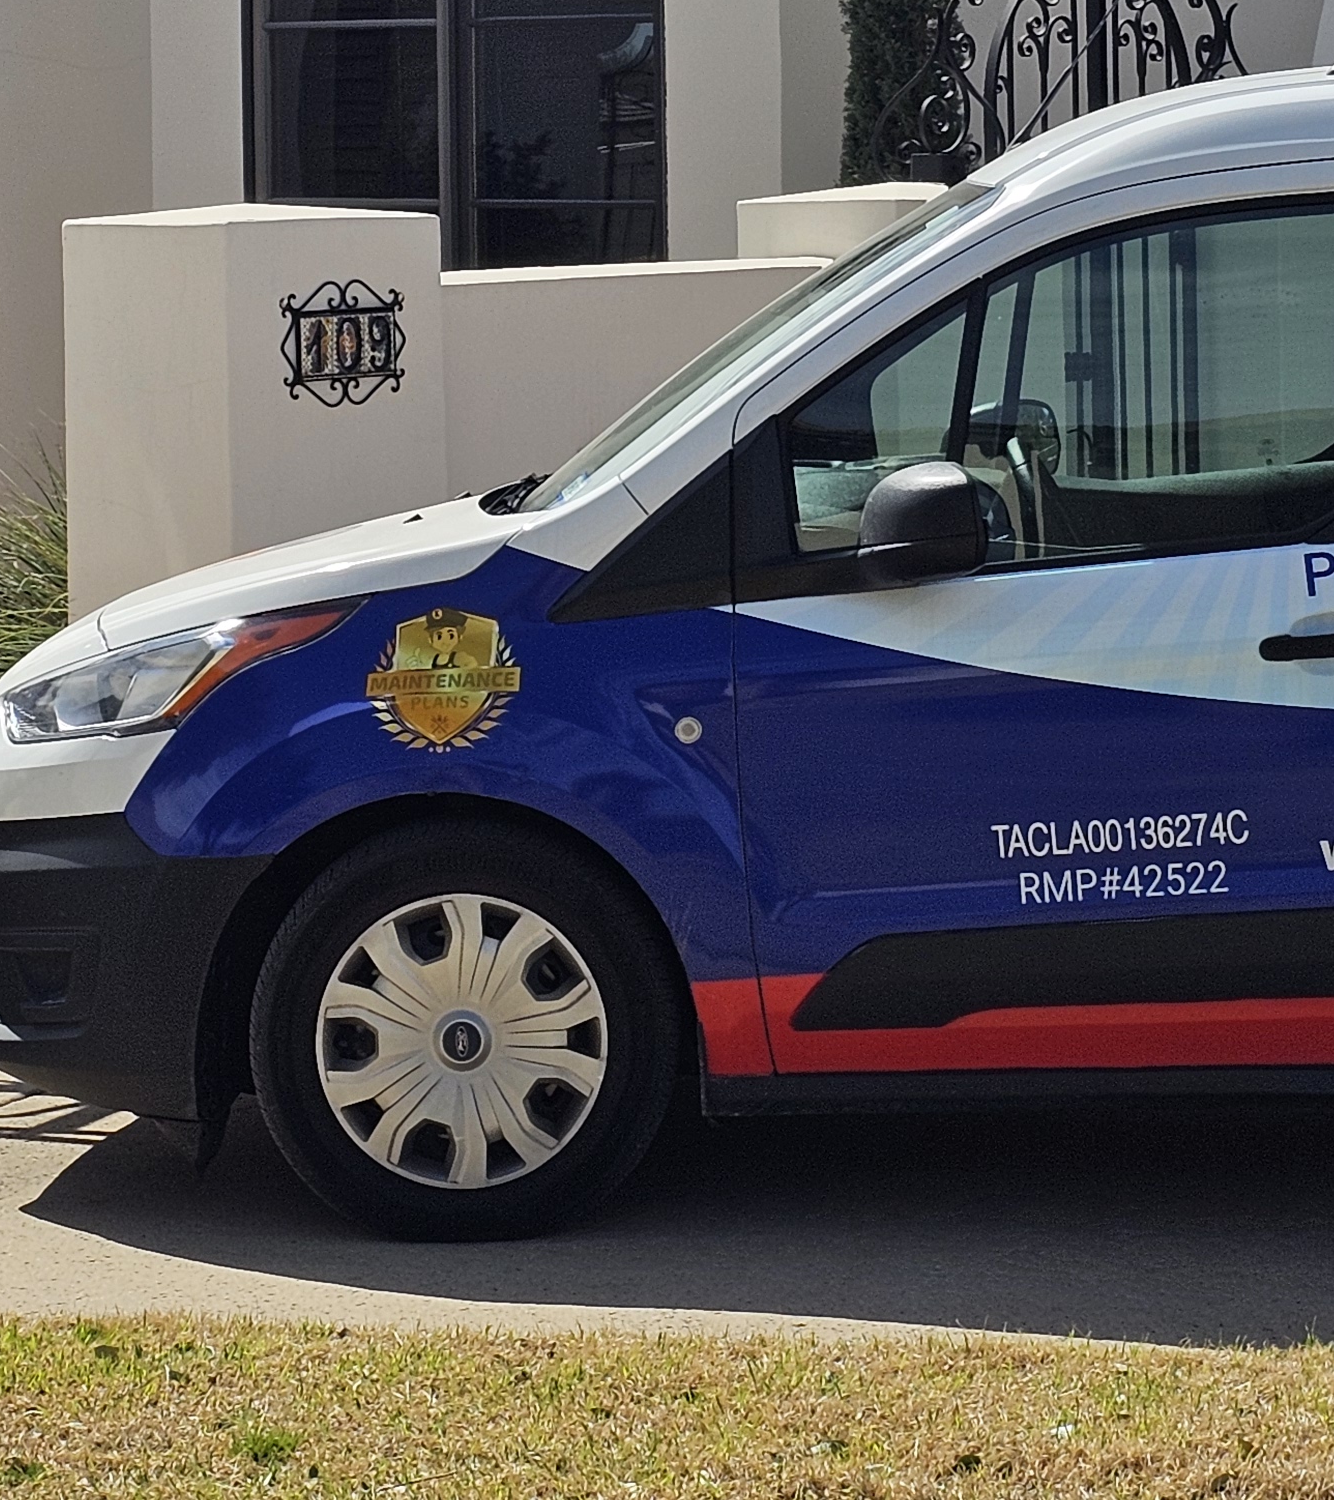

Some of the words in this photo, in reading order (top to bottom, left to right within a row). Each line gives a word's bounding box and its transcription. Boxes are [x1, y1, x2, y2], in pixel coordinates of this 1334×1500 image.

[306, 314, 392, 374] 109
[370, 671, 516, 692] MAINTENANCE
[410, 695, 470, 711] PLANS
[990, 809, 1250, 859] TACLA00136274C
[1019, 860, 1229, 904] RMP#42522
